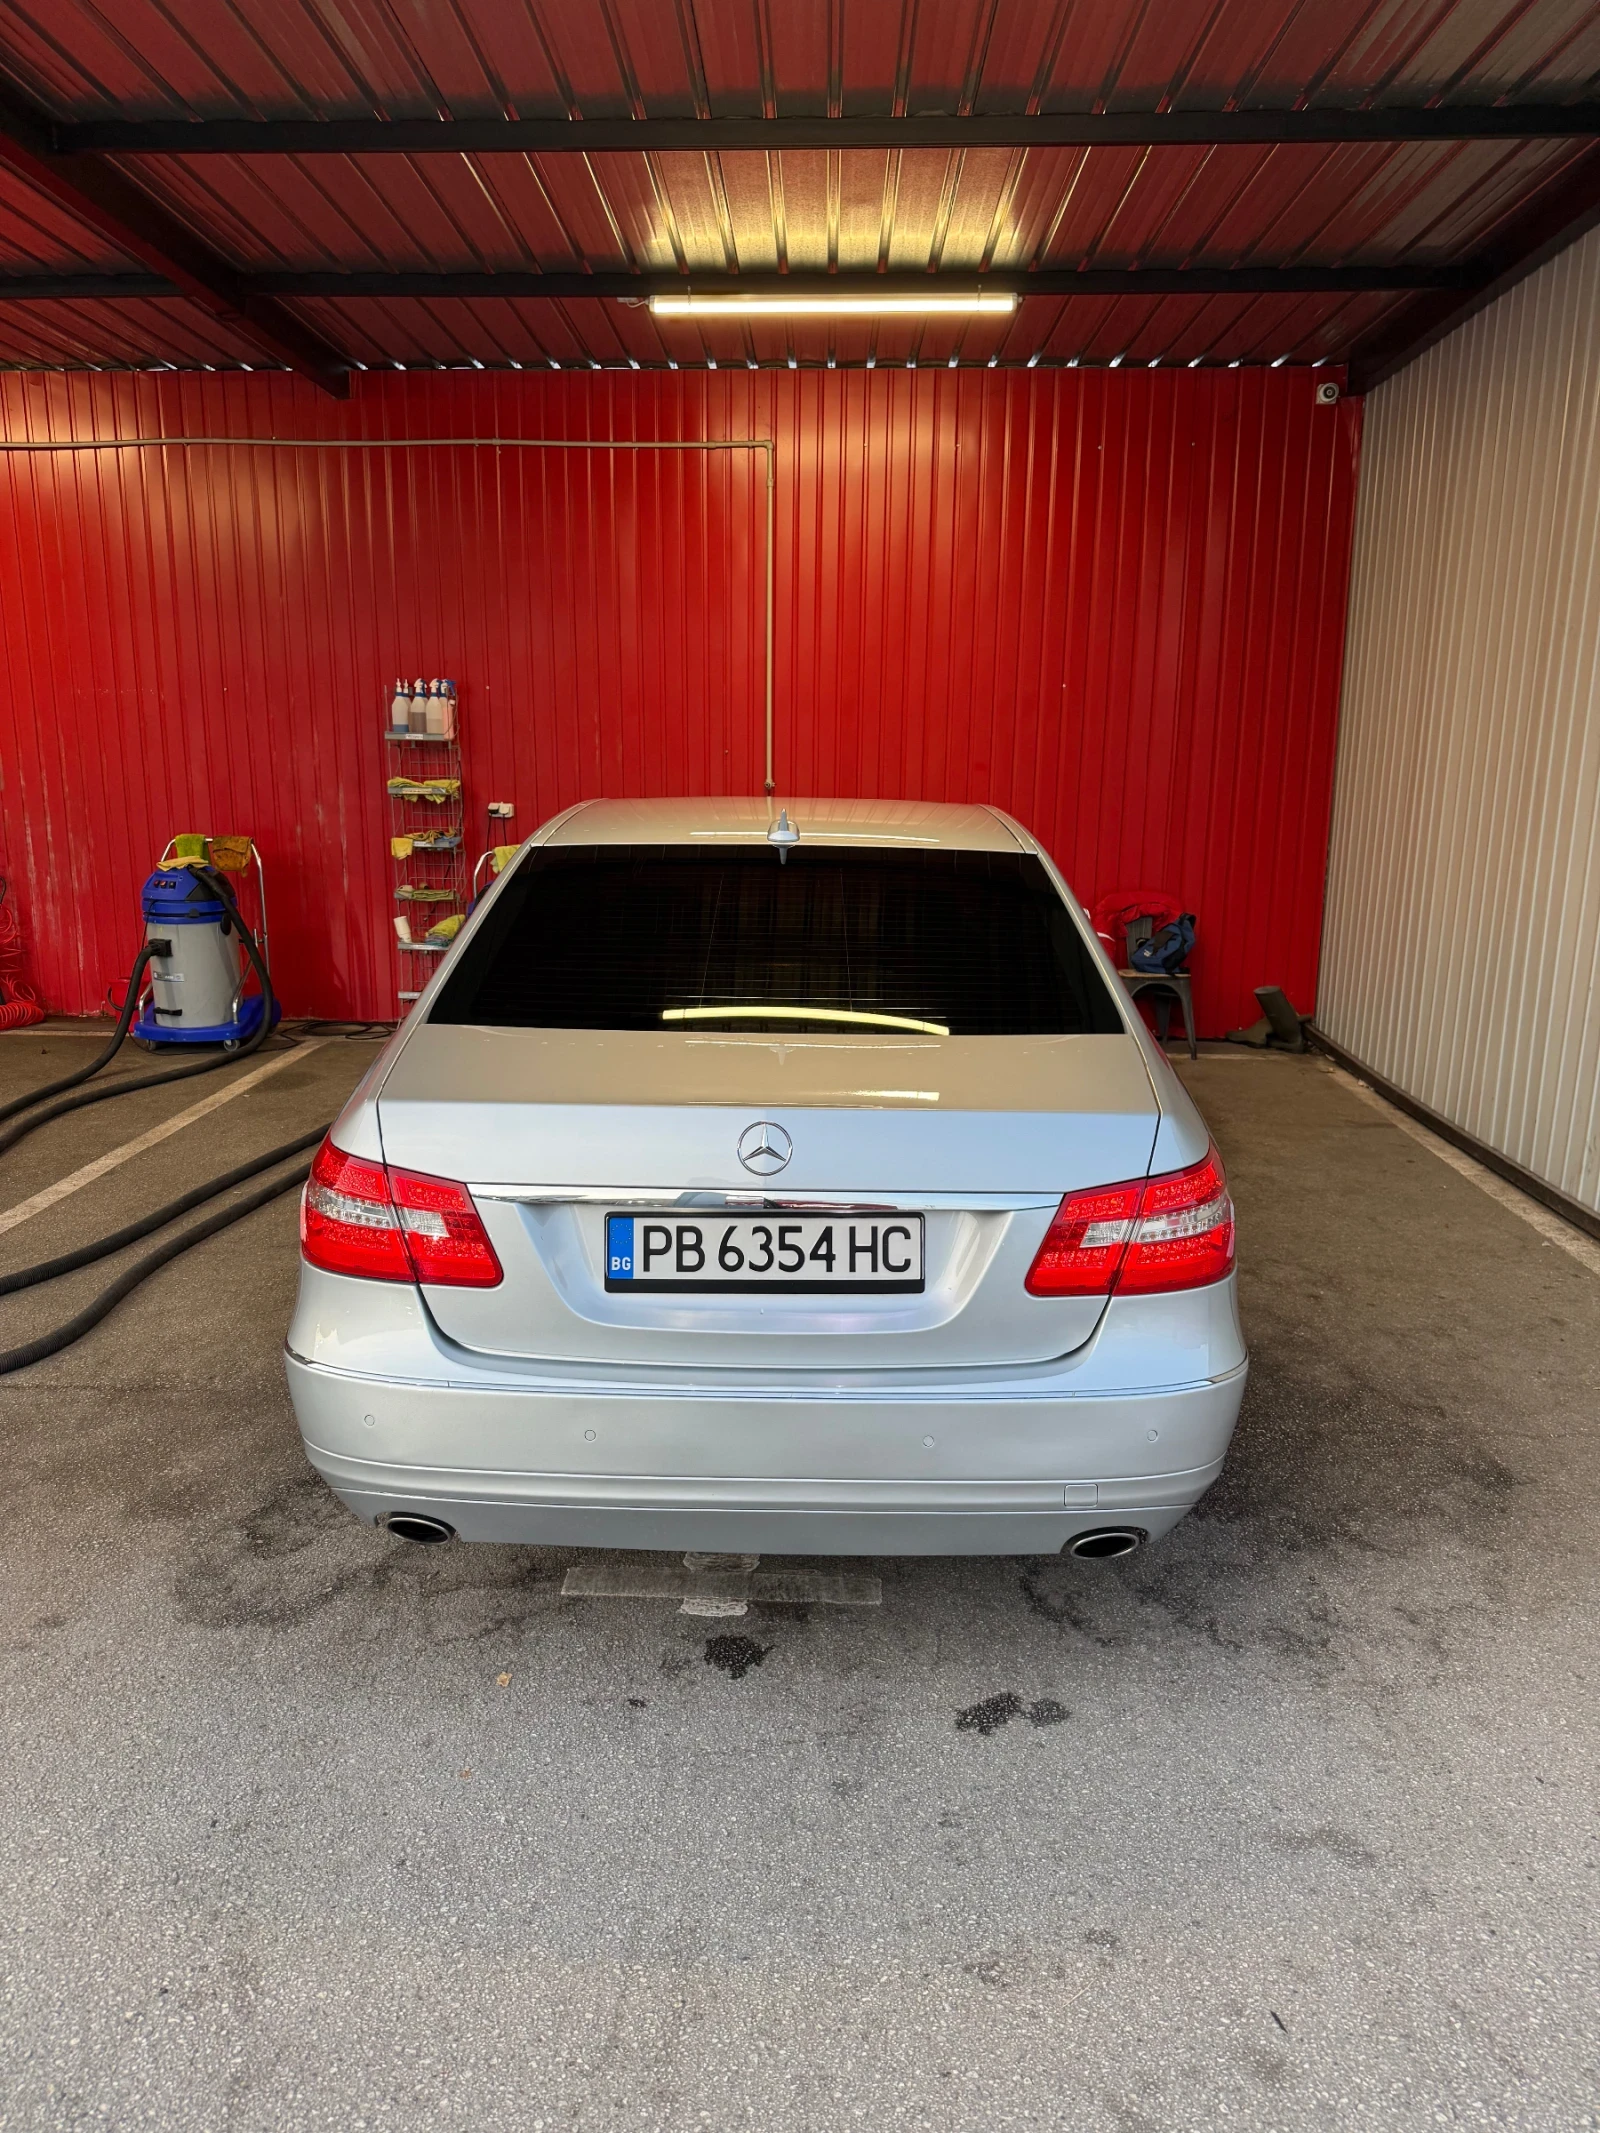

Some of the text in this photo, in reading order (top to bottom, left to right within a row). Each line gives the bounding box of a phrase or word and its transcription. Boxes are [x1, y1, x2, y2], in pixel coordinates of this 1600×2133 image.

[643, 1225, 911, 1272] PB 6354 HC
[611, 1257, 631, 1271] BG
